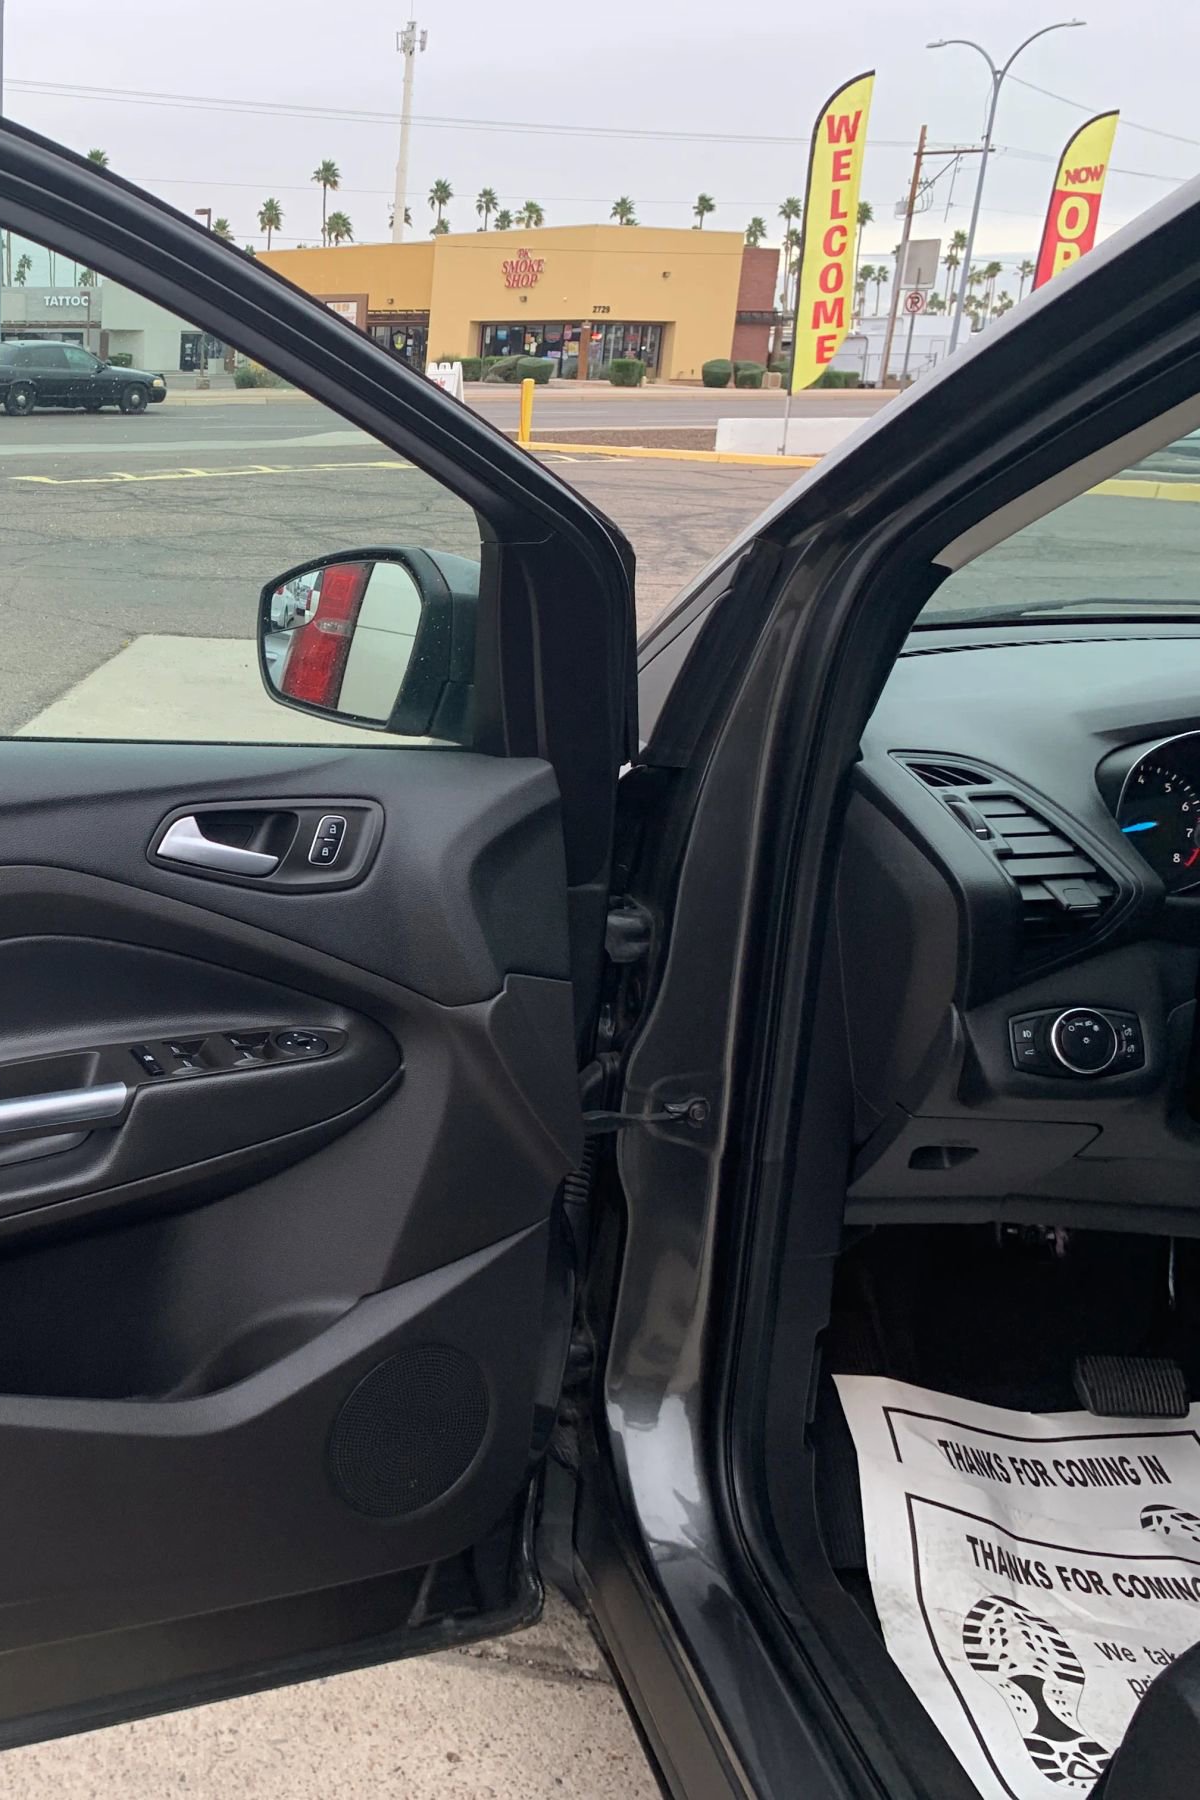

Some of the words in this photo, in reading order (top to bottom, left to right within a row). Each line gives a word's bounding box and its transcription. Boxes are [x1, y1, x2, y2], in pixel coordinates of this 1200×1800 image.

[1064, 164, 1104, 186] NOW
[811, 110, 862, 364] WELCOME
[1052, 196, 1090, 276] OP
[502, 259, 544, 274] SMOKE
[505, 273, 538, 288] SHOP
[1138, 775, 1145, 784] 4
[1165, 783, 1172, 793] 5
[1181, 802, 1189, 812] 6
[1186, 828, 1193, 838] 7
[1173, 853, 1180, 863] 8
[937, 1439, 1011, 1484] THANKS
[1008, 1456, 1057, 1487] FOR
[1053, 1456, 1141, 1488] COMING
[1137, 1455, 1172, 1484] IN
[966, 1534, 1053, 1590] THANKS
[1055, 1565, 1112, 1597] FOR
[1093, 1642, 1136, 1662] We
[1142, 1646, 1176, 1666] tak
